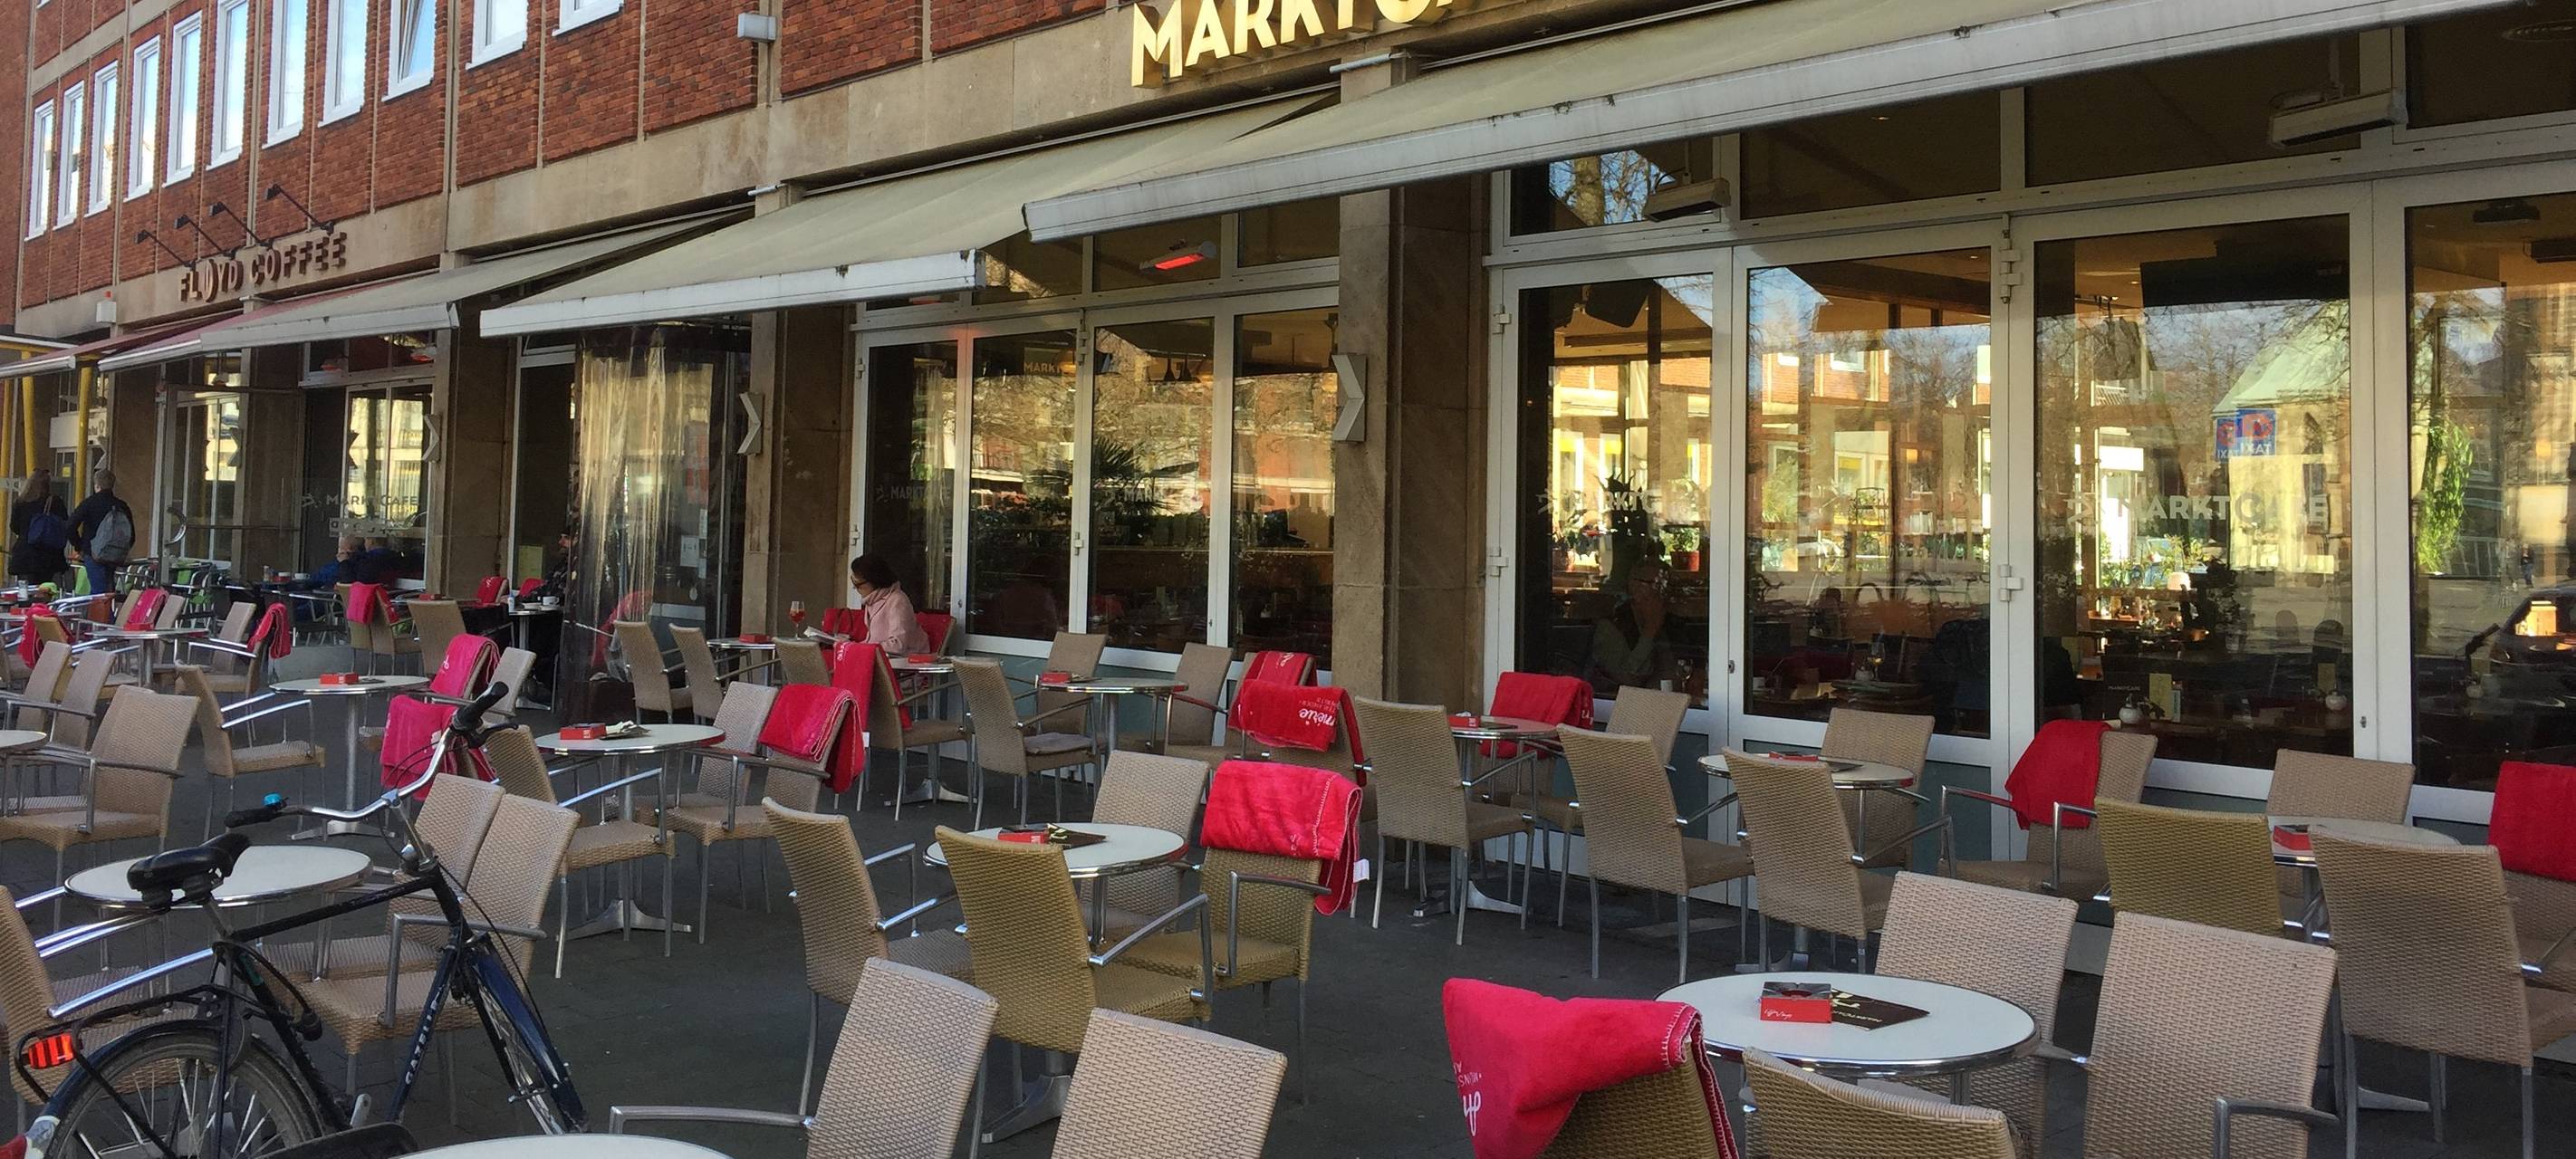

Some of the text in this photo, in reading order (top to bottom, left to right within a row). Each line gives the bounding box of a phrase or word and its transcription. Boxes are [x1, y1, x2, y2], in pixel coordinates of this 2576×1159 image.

[179, 232, 348, 302] FLOYD COFFEE
[405, 1000, 438, 1085] GAZELLE
